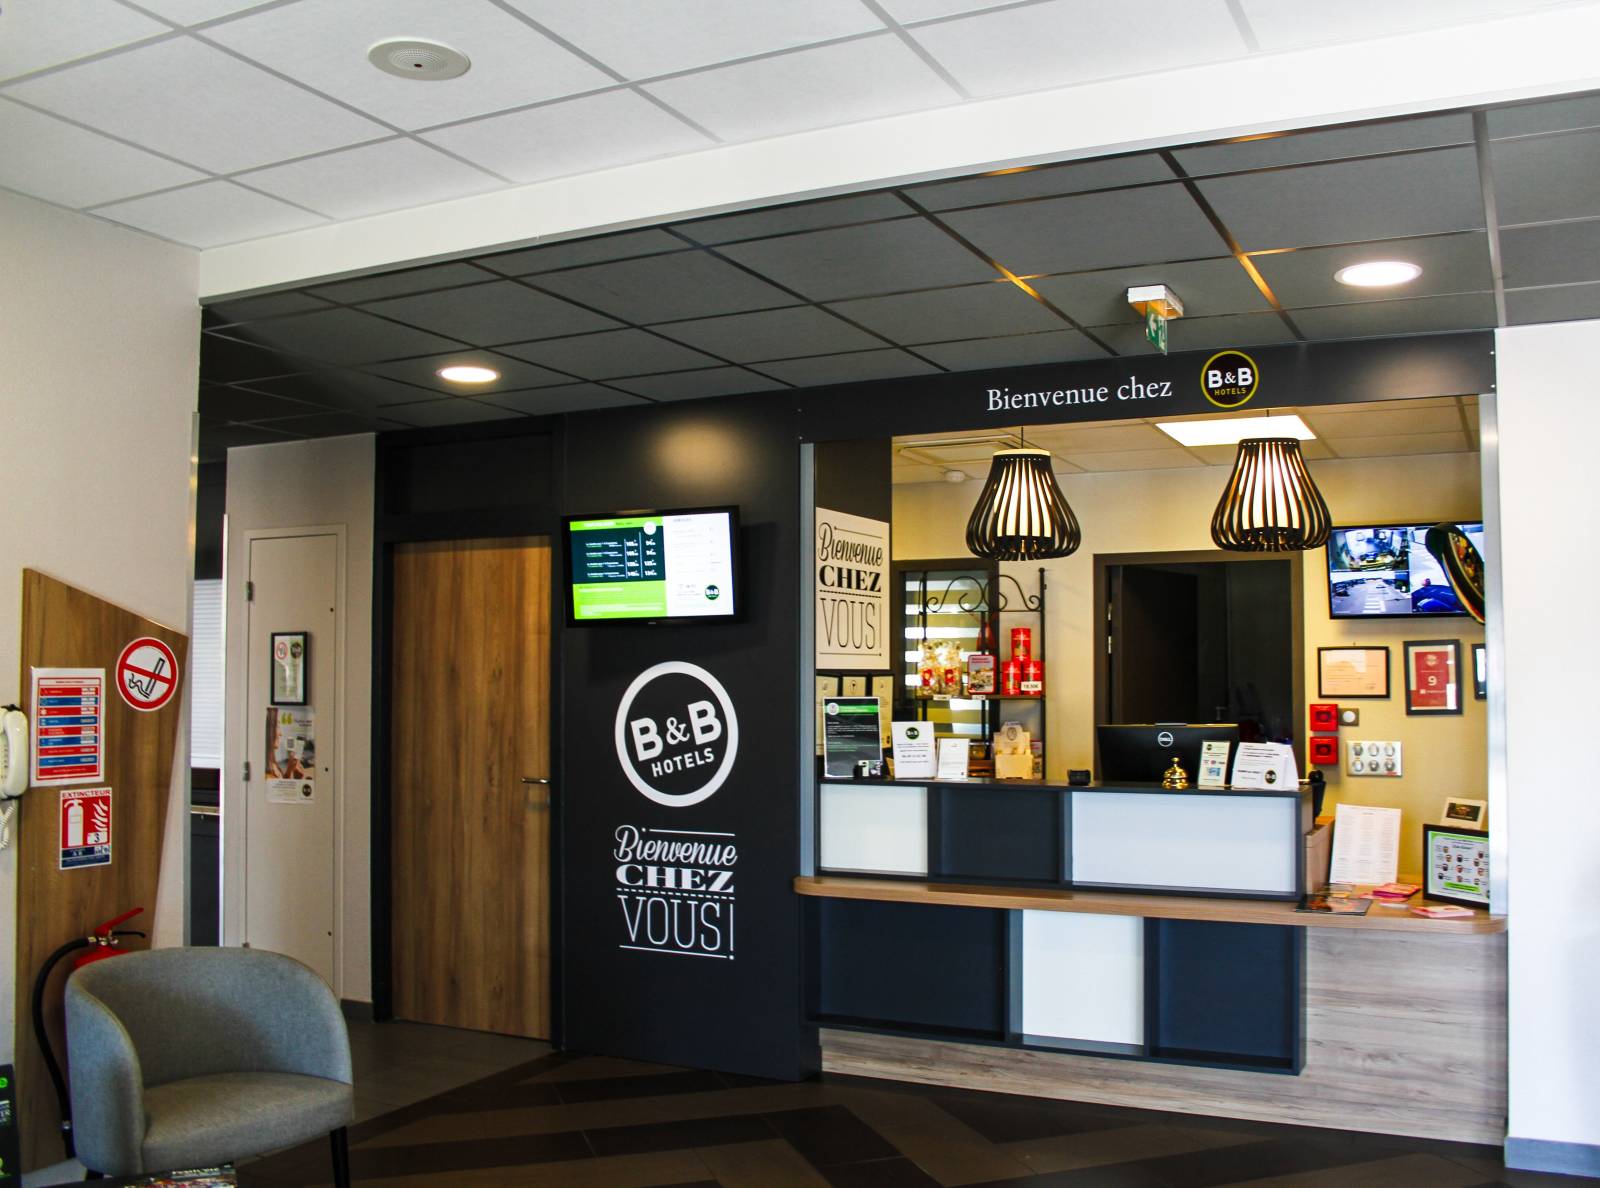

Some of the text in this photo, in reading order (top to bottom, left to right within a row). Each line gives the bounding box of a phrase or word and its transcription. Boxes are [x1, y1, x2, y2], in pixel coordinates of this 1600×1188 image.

[986, 375, 1173, 411] Bienvenue chez
[1207, 367, 1254, 389] B&B
[1213, 386, 1247, 396] HOTELS
[818, 522, 884, 567] Bienvenue
[819, 564, 882, 593] CHEZ
[1427, 675, 1438, 687] 9
[630, 699, 723, 762] B&B
[651, 747, 715, 778] HOTELS
[62, 789, 111, 799] EXTINCTEUR
[613, 824, 738, 866] Bienvenue
[615, 864, 735, 893] CHEZ
[617, 894, 735, 961] VOUS!
